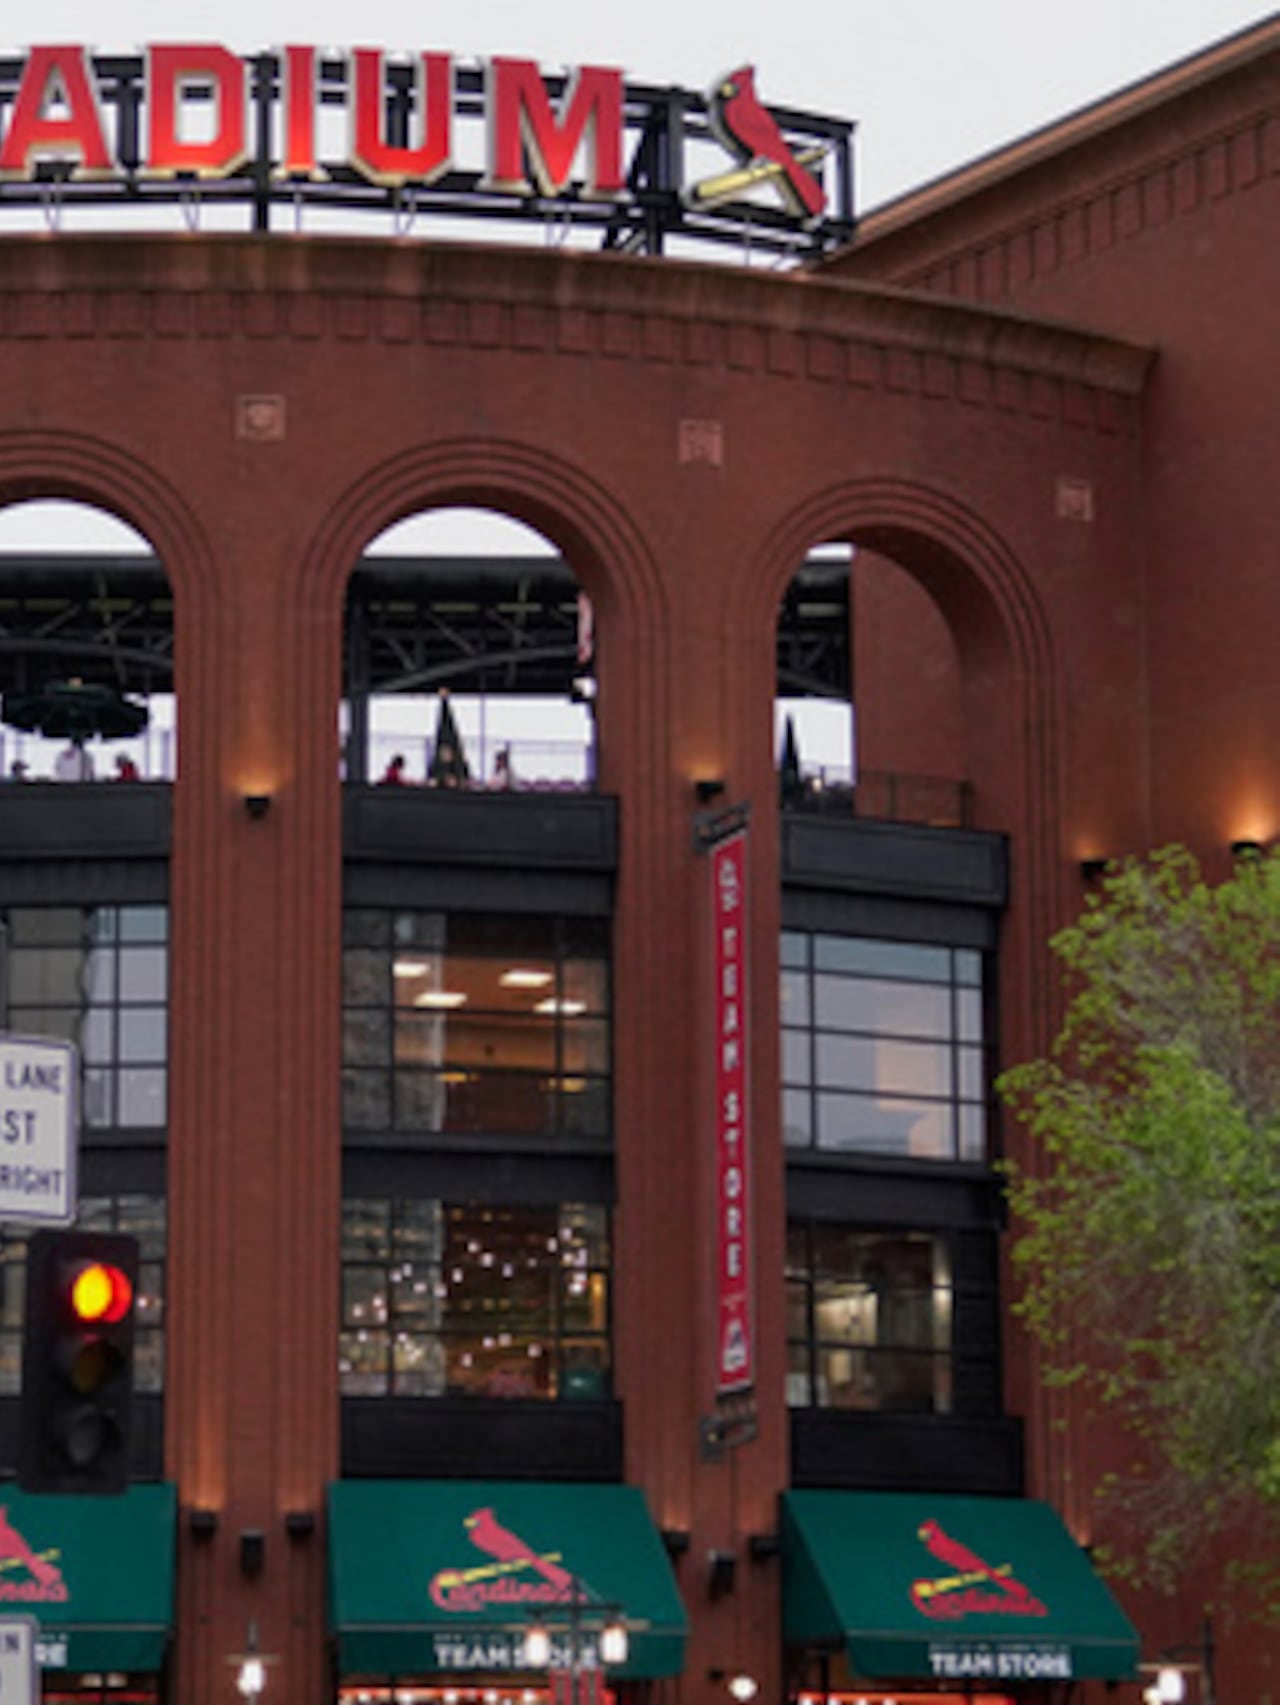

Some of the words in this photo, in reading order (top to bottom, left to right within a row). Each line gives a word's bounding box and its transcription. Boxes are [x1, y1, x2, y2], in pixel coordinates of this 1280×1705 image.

[5, 1061, 61, 1094] LANE
[434, 1643, 510, 1668] TEAM
[930, 1652, 992, 1676] TEAM
[997, 1653, 1072, 1677] STORE
